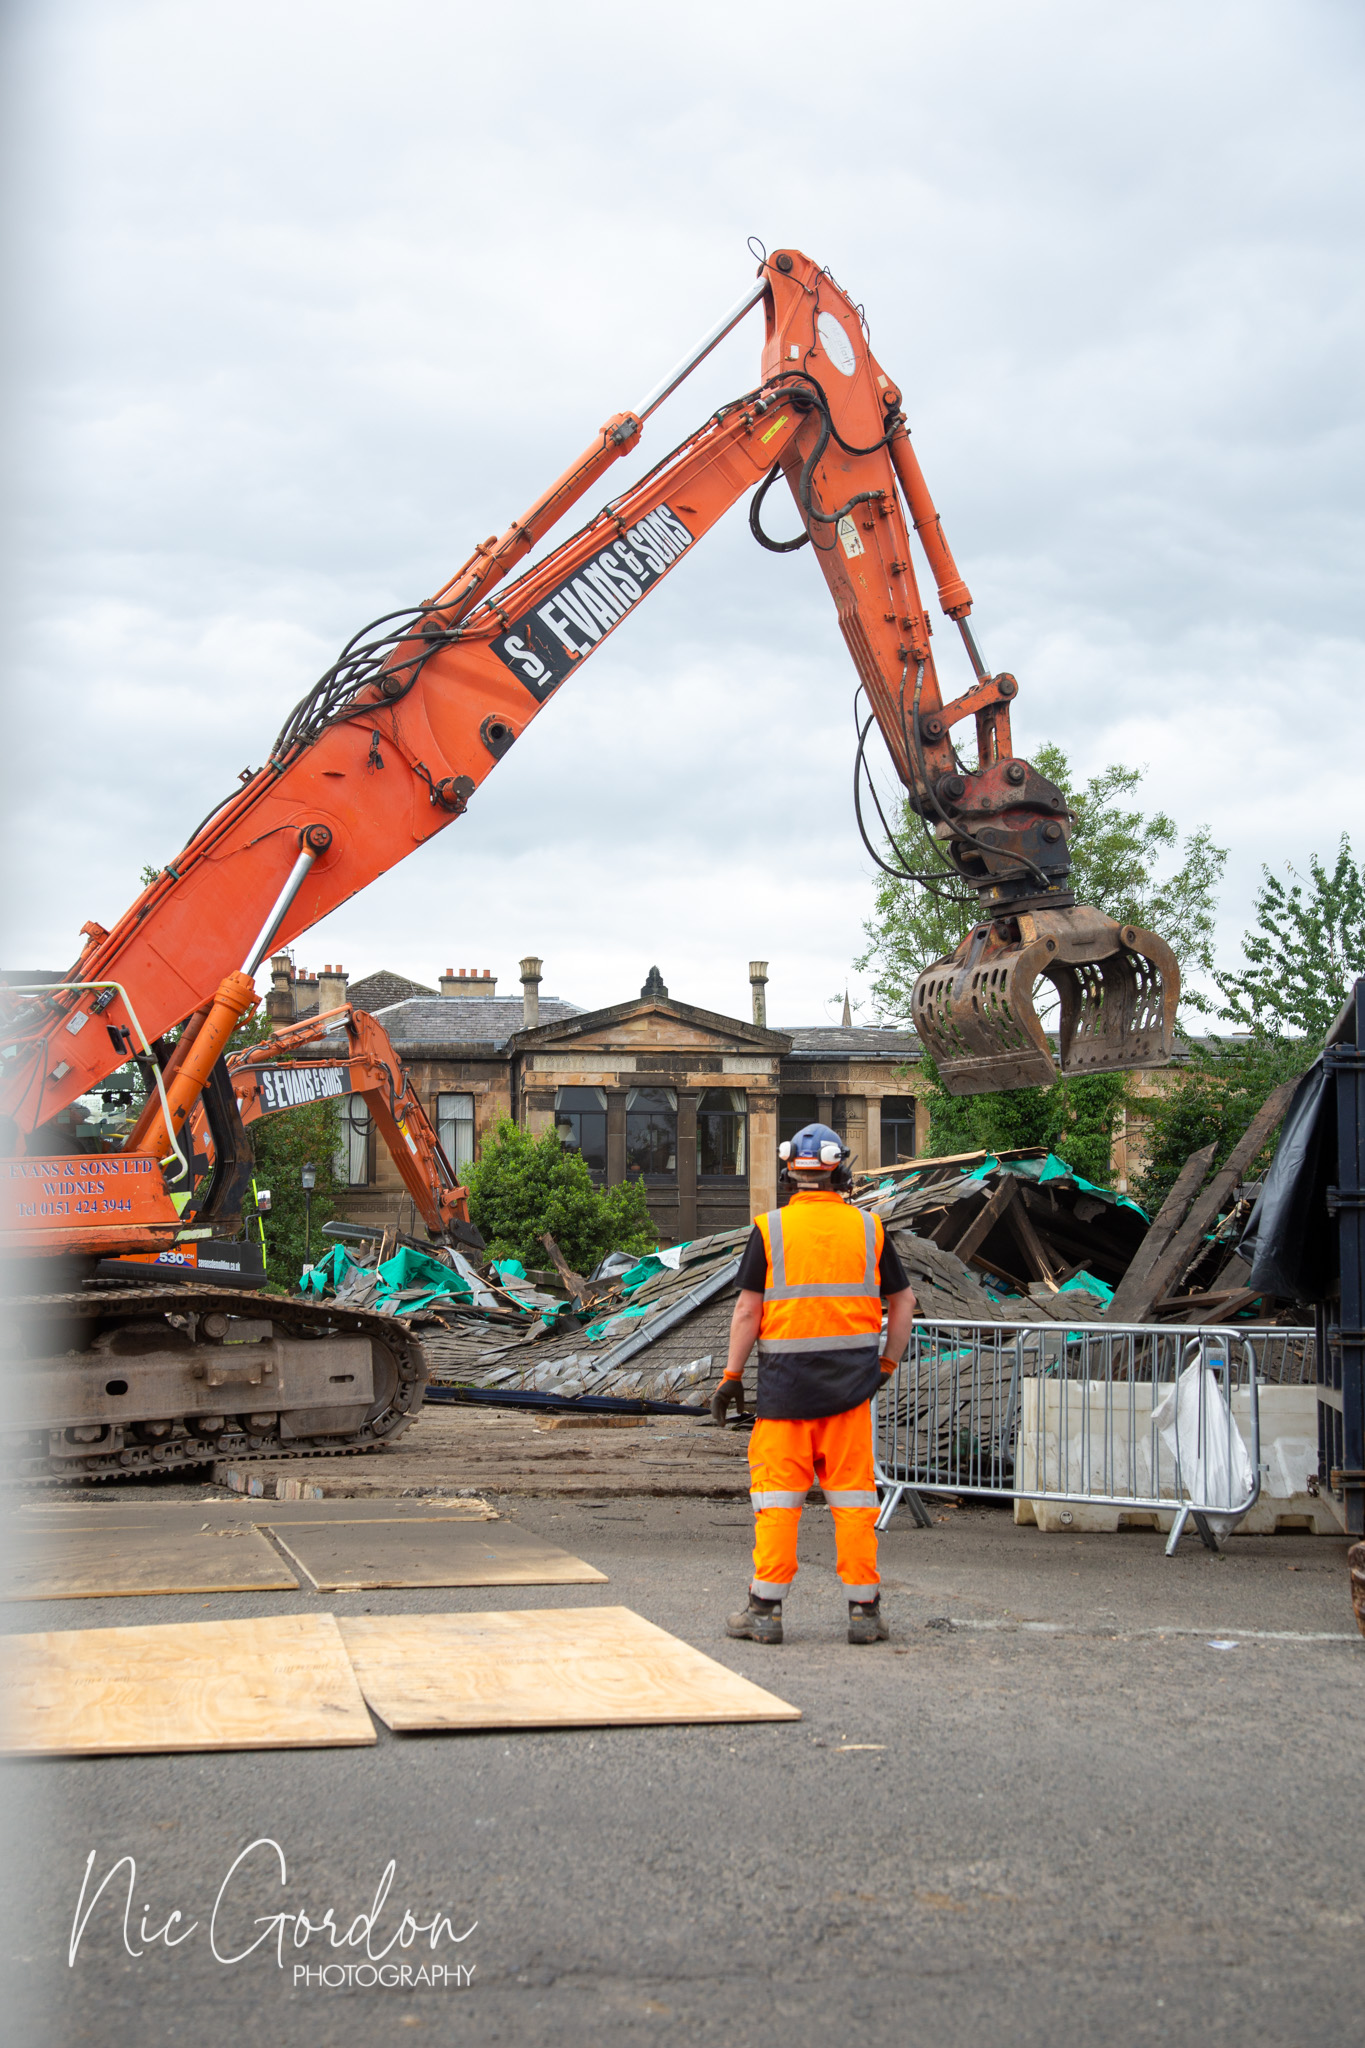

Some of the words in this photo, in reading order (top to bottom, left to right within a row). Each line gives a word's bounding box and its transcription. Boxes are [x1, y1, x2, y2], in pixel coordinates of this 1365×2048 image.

[626, 504, 693, 575] SONS
[612, 540, 650, 582] &
[536, 552, 643, 657] EVANS
[273, 1068, 315, 1108] EVANS
[312, 1068, 322, 1097] &
[318, 1067, 343, 1098] SONS
[9, 1163, 59, 1178] EVANS
[63, 1163, 75, 1176] &
[79, 1161, 119, 1175] SONS
[122, 1160, 152, 1174] LTD
[42, 1180, 105, 1196] WIDNES
[15, 1202, 36, 1217] Tel
[40, 1201, 70, 1216] 0151
[74, 1200, 97, 1214] 424
[100, 1198, 131, 1213] 3944
